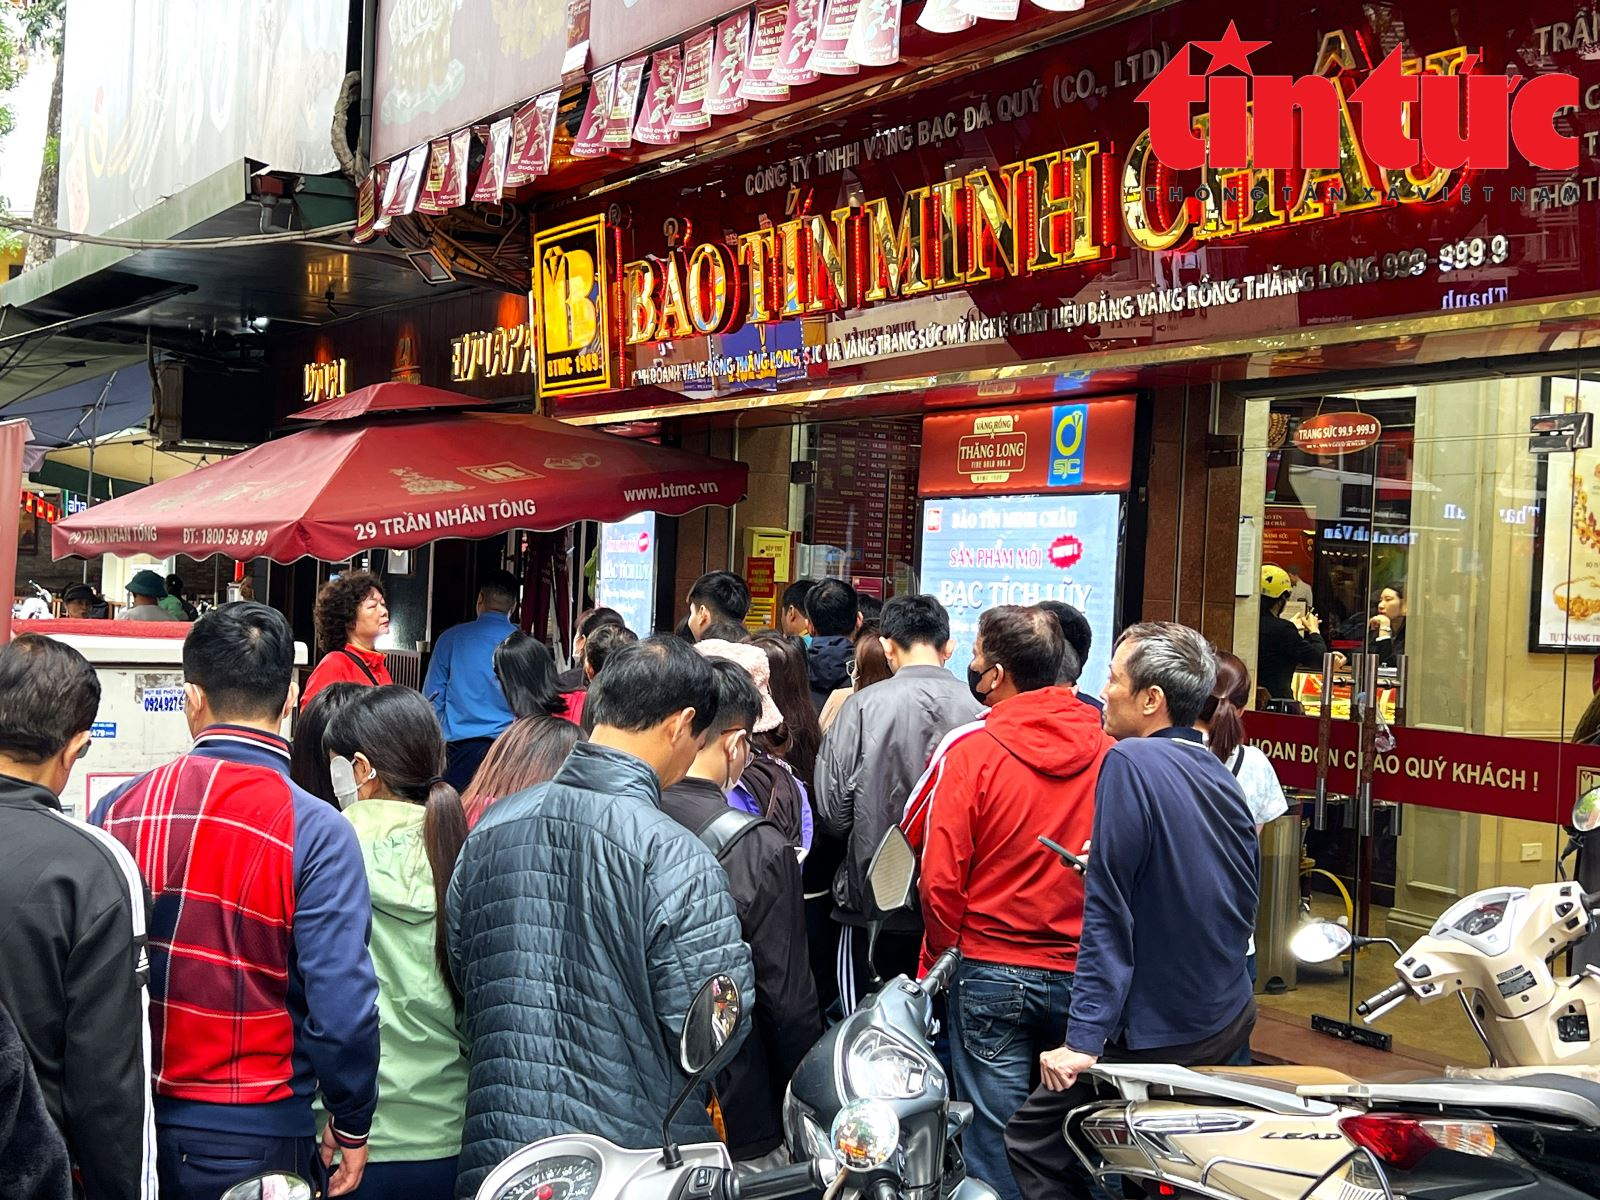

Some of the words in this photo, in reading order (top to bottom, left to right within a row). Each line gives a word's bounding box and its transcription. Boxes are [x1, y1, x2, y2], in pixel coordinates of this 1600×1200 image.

[745, 164, 787, 196] CÔNG
[789, 154, 812, 183] TY
[816, 142, 860, 176] TNHH
[917, 112, 957, 148] BẠC
[997, 79, 1044, 122] QUÝ
[624, 216, 727, 346] BẢO
[738, 187, 852, 325] TÍN
[865, 141, 1101, 302] MINH
[736, 350, 769, 371] THĂNG
[825, 338, 842, 361] VÀ
[843, 334, 874, 359] VÀNG
[875, 330, 917, 355] TRANG
[918, 322, 944, 350] SỨC
[1011, 303, 1049, 334] CHẤT
[1087, 289, 1135, 325] BẰNG
[1137, 284, 1185, 317] VÀNG
[1187, 273, 1241, 310] RỒNG
[1243, 264, 1315, 301] THĂNG
[1318, 256, 1380, 289] LONG
[547, 355, 573, 378] BTMC
[975, 420, 993, 431] VÀNG
[1299, 428, 1323, 441] TRANG
[1322, 425, 1338, 439] SỨC
[960, 442, 994, 460] THĂNG
[996, 442, 1024, 458] LONG
[623, 481, 719, 503] www.btmc.vn
[353, 519, 378, 541] 29
[380, 512, 432, 536] TRẦN
[435, 504, 486, 528] NHÂN
[488, 499, 537, 520] TÔNG
[182, 528, 199, 544] ĐT:
[201, 528, 224, 545] 1800
[226, 529, 239, 545] 58
[240, 529, 253, 546] 58
[254, 529, 268, 547] 99
[949, 541, 974, 568] SẢN
[976, 534, 1015, 569] PHẨM
[1017, 543, 1043, 568] MỚI
[940, 581, 984, 615] BẠC
[988, 575, 1040, 607] TÍCH
[1405, 755, 1448, 781] QUÝ
[1452, 761, 1526, 791] KHÁCH
[1260, 1132, 1342, 1140] LEAD
